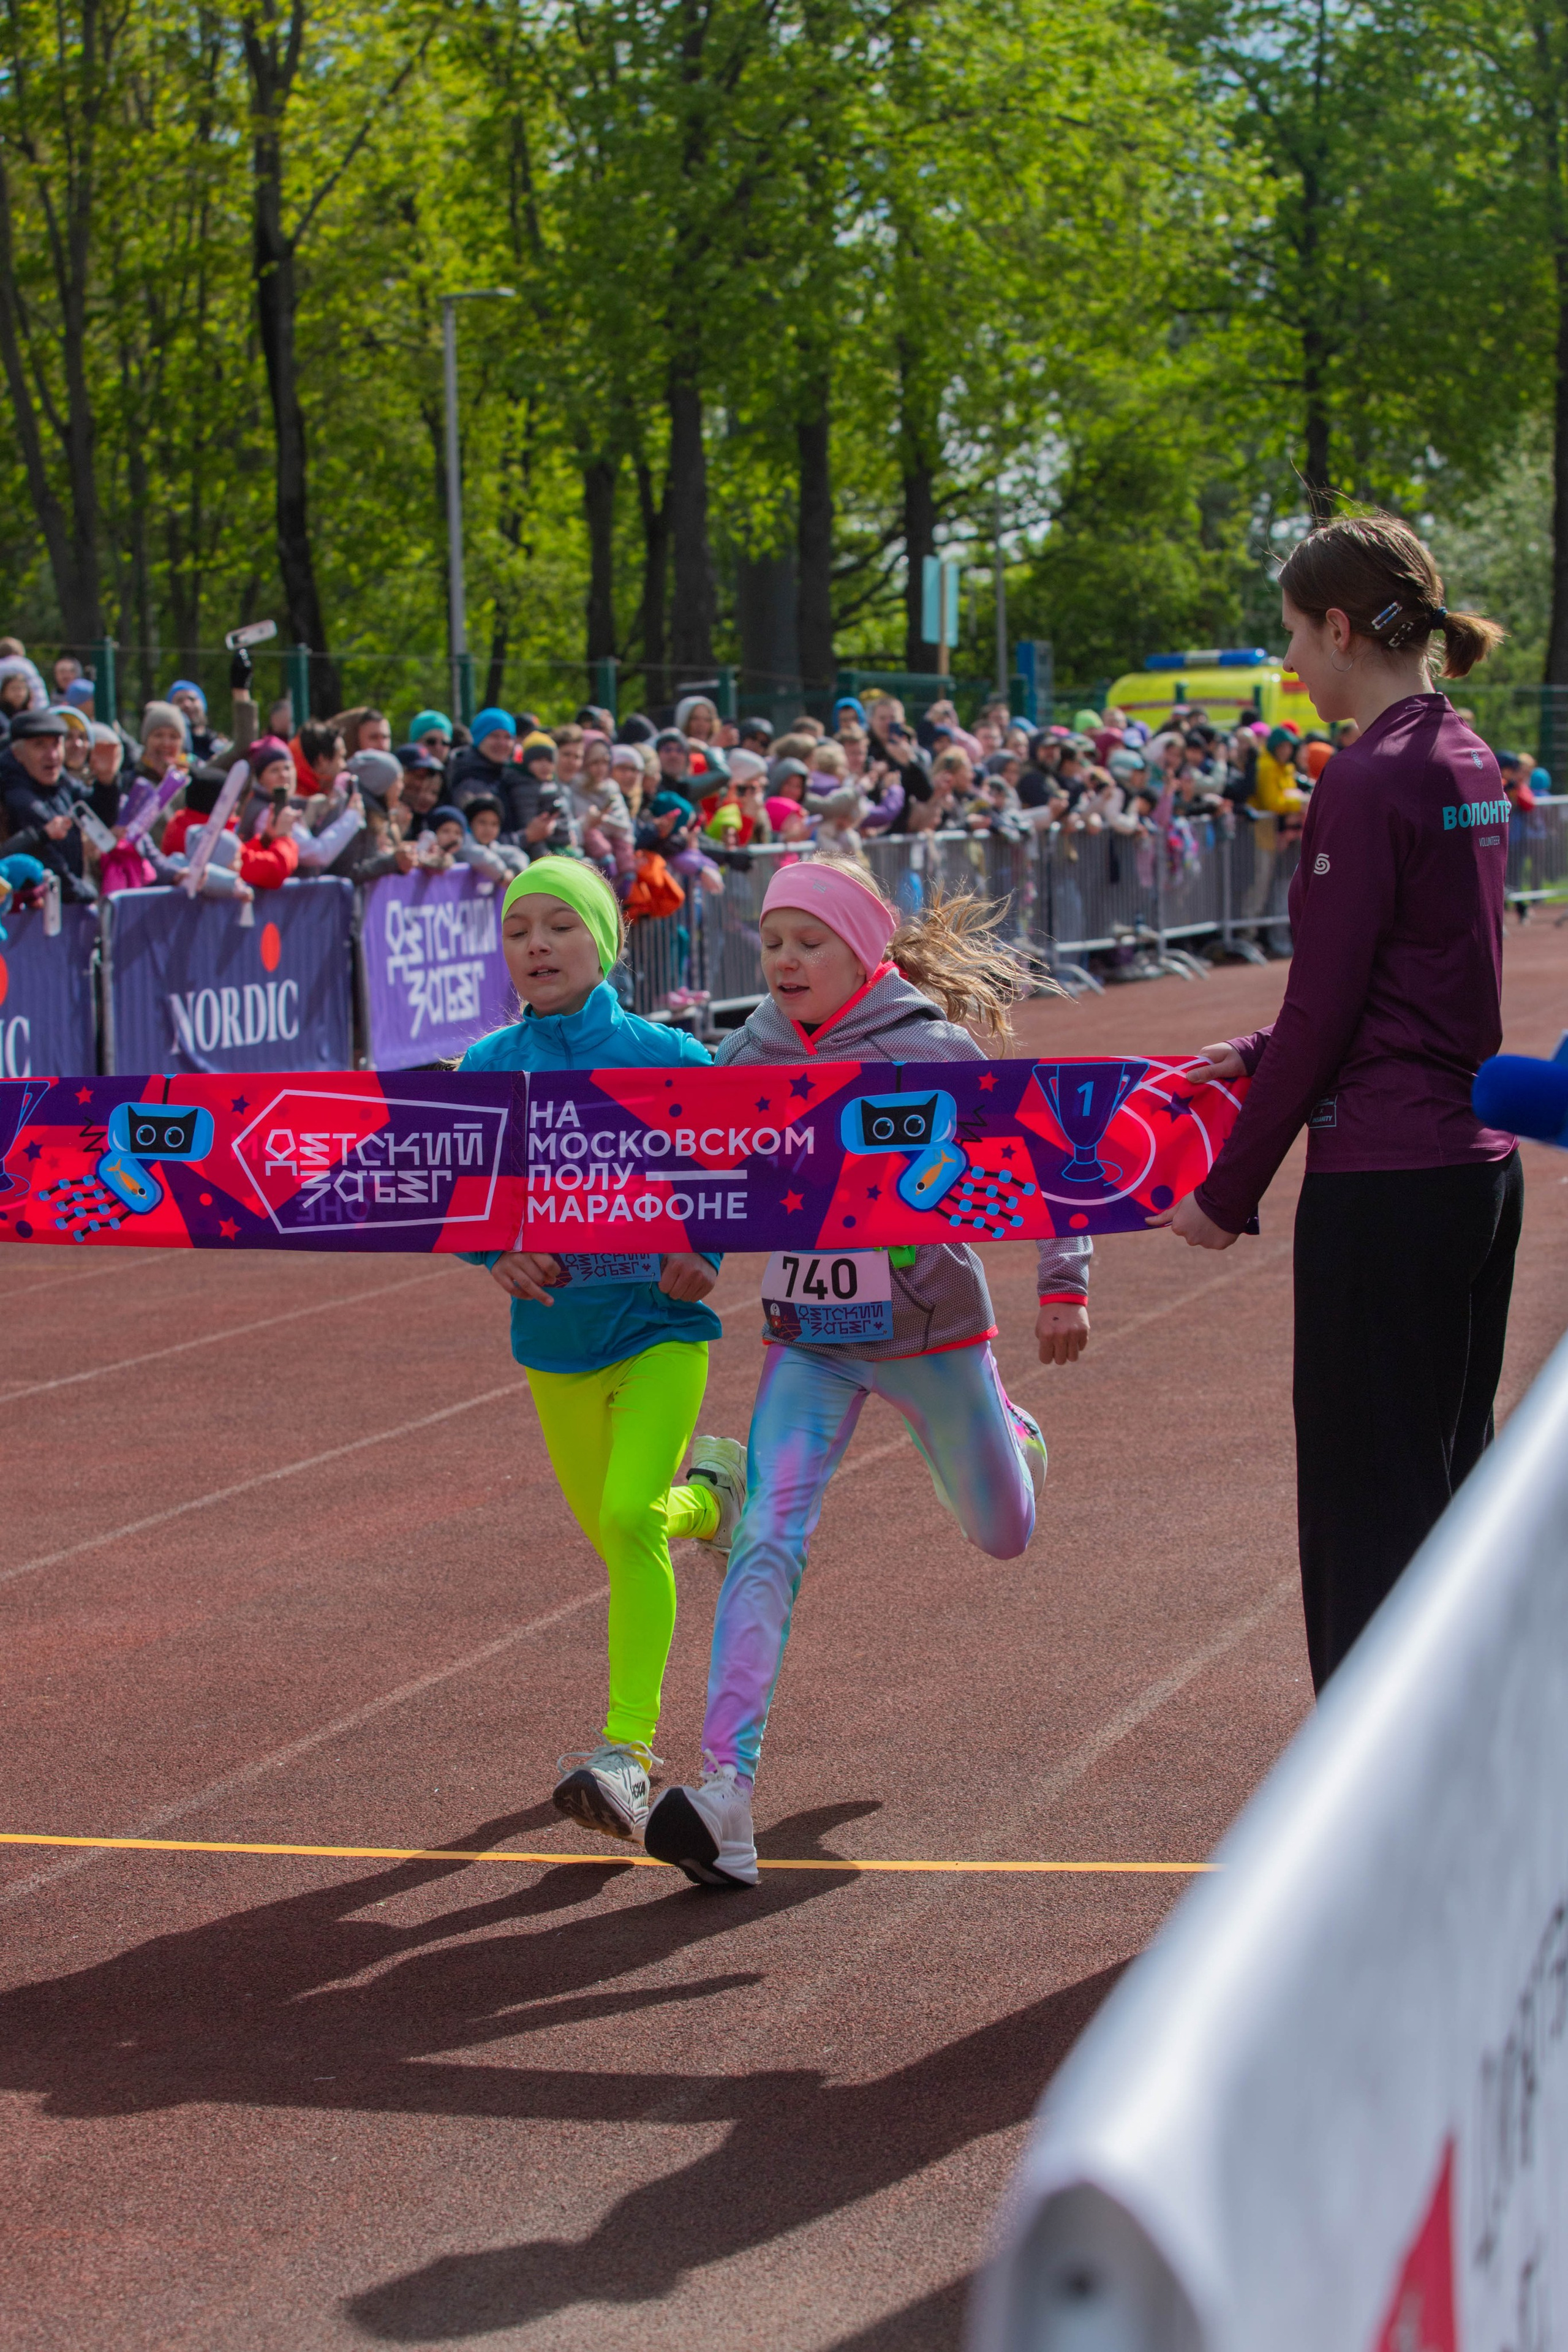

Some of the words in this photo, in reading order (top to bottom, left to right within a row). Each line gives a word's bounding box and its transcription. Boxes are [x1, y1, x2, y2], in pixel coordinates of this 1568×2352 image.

[1442, 799, 1512, 830] ВОЛОНТЕ
[1478, 835, 1501, 847] VOLUNTEER
[169, 978, 300, 1056] NORDIC
[1077, 1080, 1095, 1117] 1
[529, 1100, 581, 1129] НА
[265, 1123, 483, 1176] ДЕТСКИЙ
[528, 1126, 815, 1161] МОСКОВСКОМ
[300, 1169, 452, 1209] ЗАБЕГ
[527, 1192, 748, 1223] МАРАФОНЕ
[580, 1261, 639, 1281] ЗАБЕГ
[782, 1256, 858, 1300] 740
[798, 1301, 883, 1324] ДЕТСКИЙ
[810, 1320, 871, 1337] ЗАБЕГ
